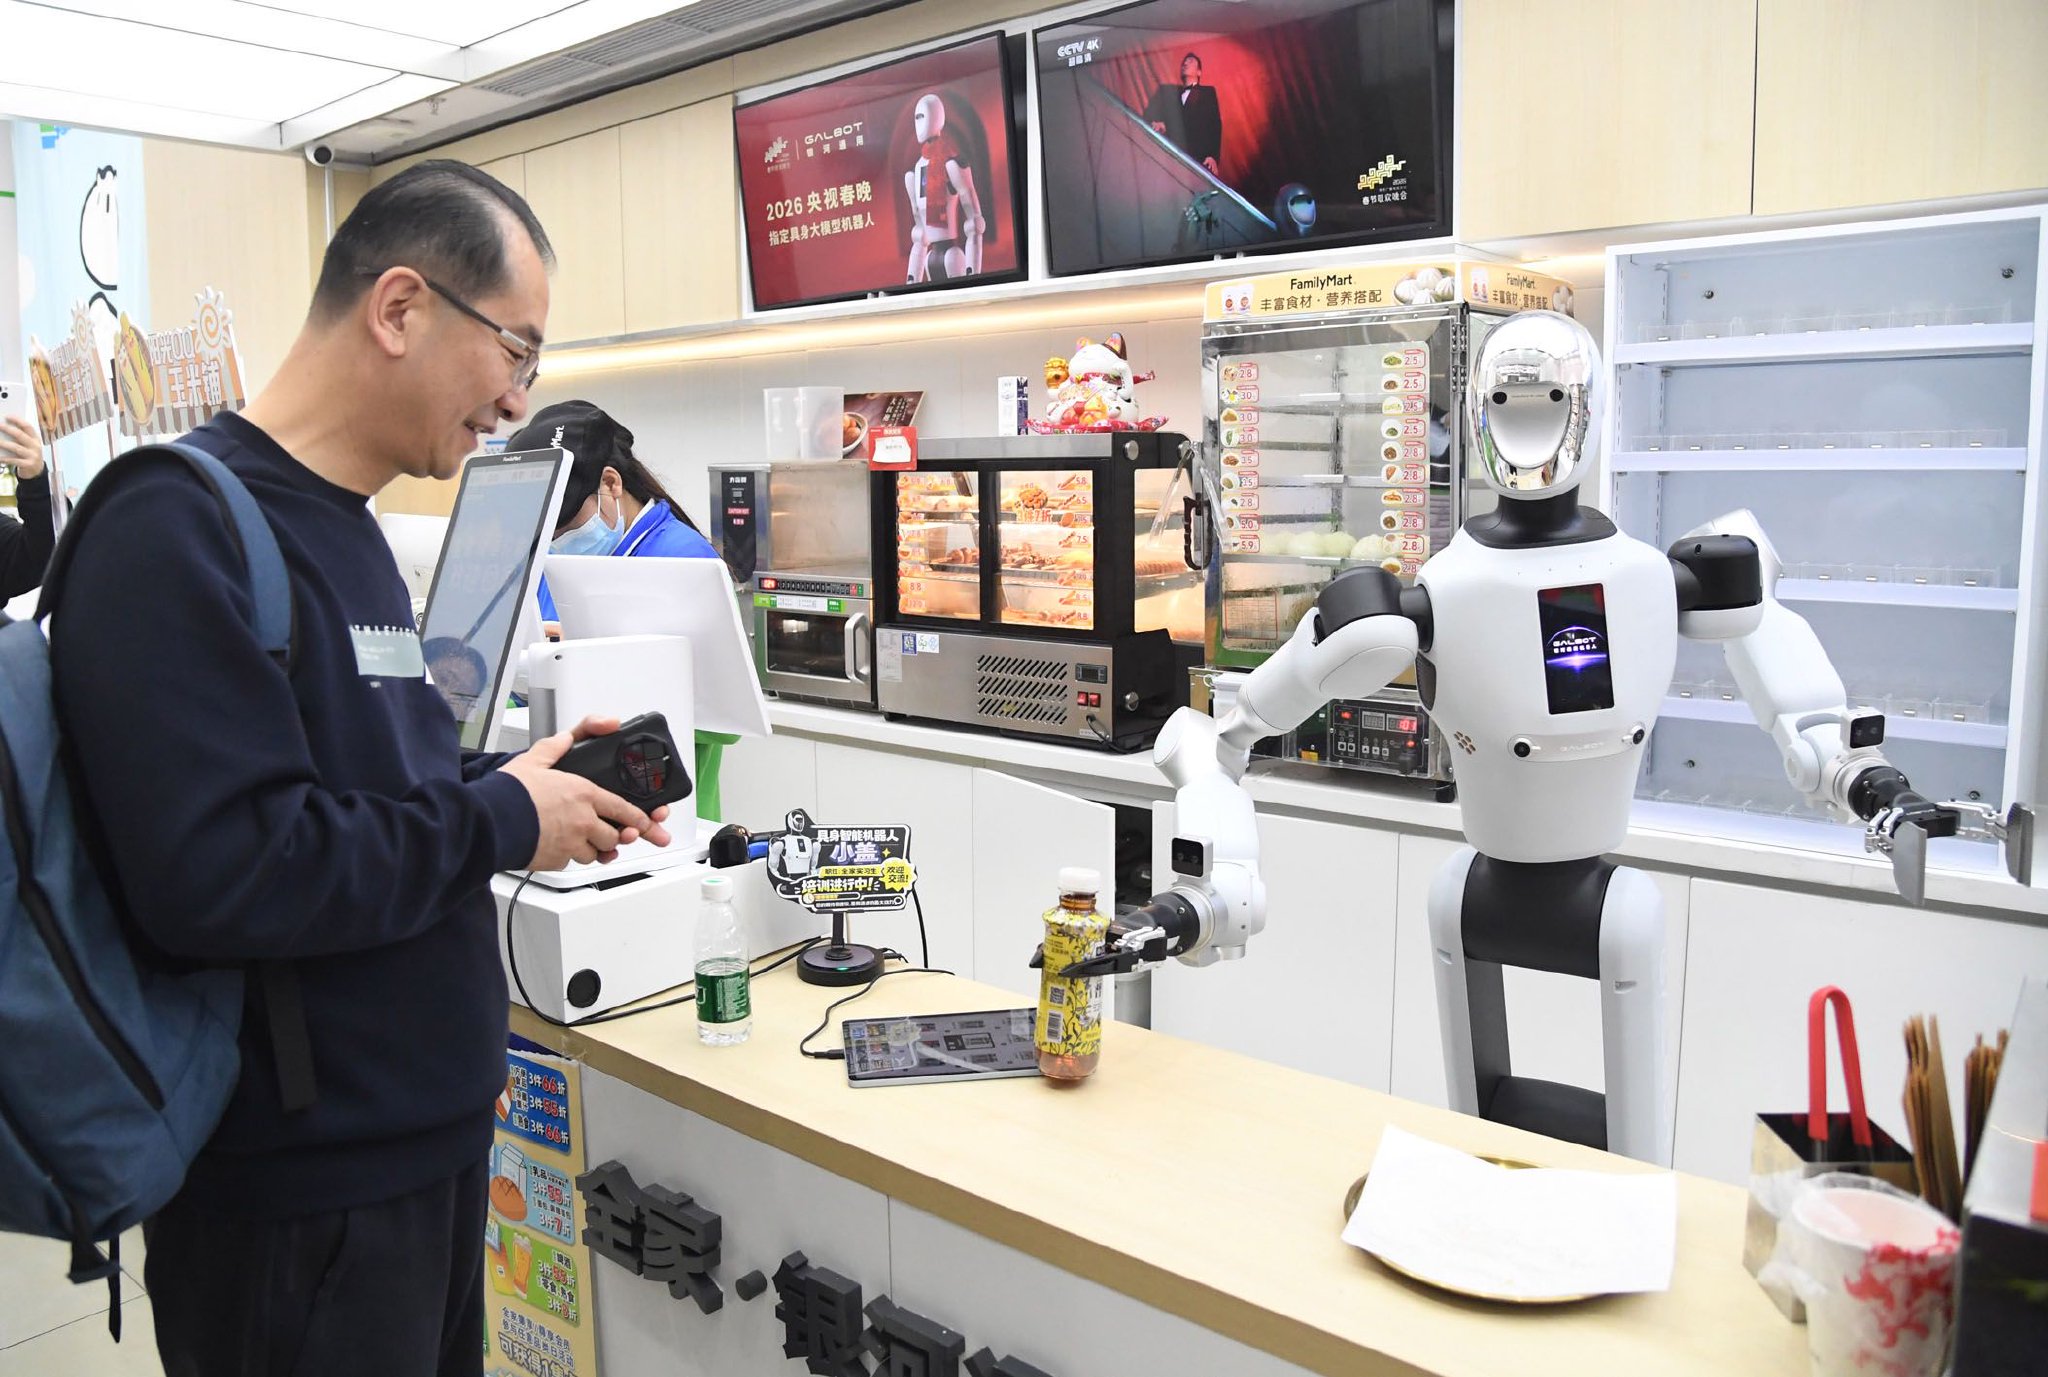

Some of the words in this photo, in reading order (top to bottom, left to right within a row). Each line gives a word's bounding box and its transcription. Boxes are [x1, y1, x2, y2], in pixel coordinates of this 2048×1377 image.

[1057, 40, 1084, 57] CCTV
[1086, 38, 1099, 50] 4K
[804, 121, 863, 145] GALBOT
[766, 197, 803, 221] 2026
[806, 180, 873, 214] 央视春晚
[768, 211, 875, 246] 指定具身大模型机器人
[1291, 274, 1353, 290] FamilyMart
[1506, 273, 1536, 290] FamilyMart
[1403, 379, 1419, 389] 2.5
[1403, 425, 1419, 434] 2.5
[1403, 470, 1418, 480] 2.8
[1402, 518, 1418, 528] 2.8
[1241, 541, 1254, 550] 5.9
[1402, 541, 1418, 551] 2.8
[817, 829, 900, 842] 具身智能机器人
[829, 841, 880, 863] 小盖
[841, 867, 878, 875] 全家实习生
[886, 865, 905, 874] 欢迎
[801, 876, 873, 895] 培训进行中!
[888, 874, 909, 884] 交流!
[528, 1072, 566, 1095] 3件66折
[530, 1095, 567, 1119] 3件55折
[531, 1119, 569, 1144] 3件66折
[540, 1211, 571, 1239] 3件7折
